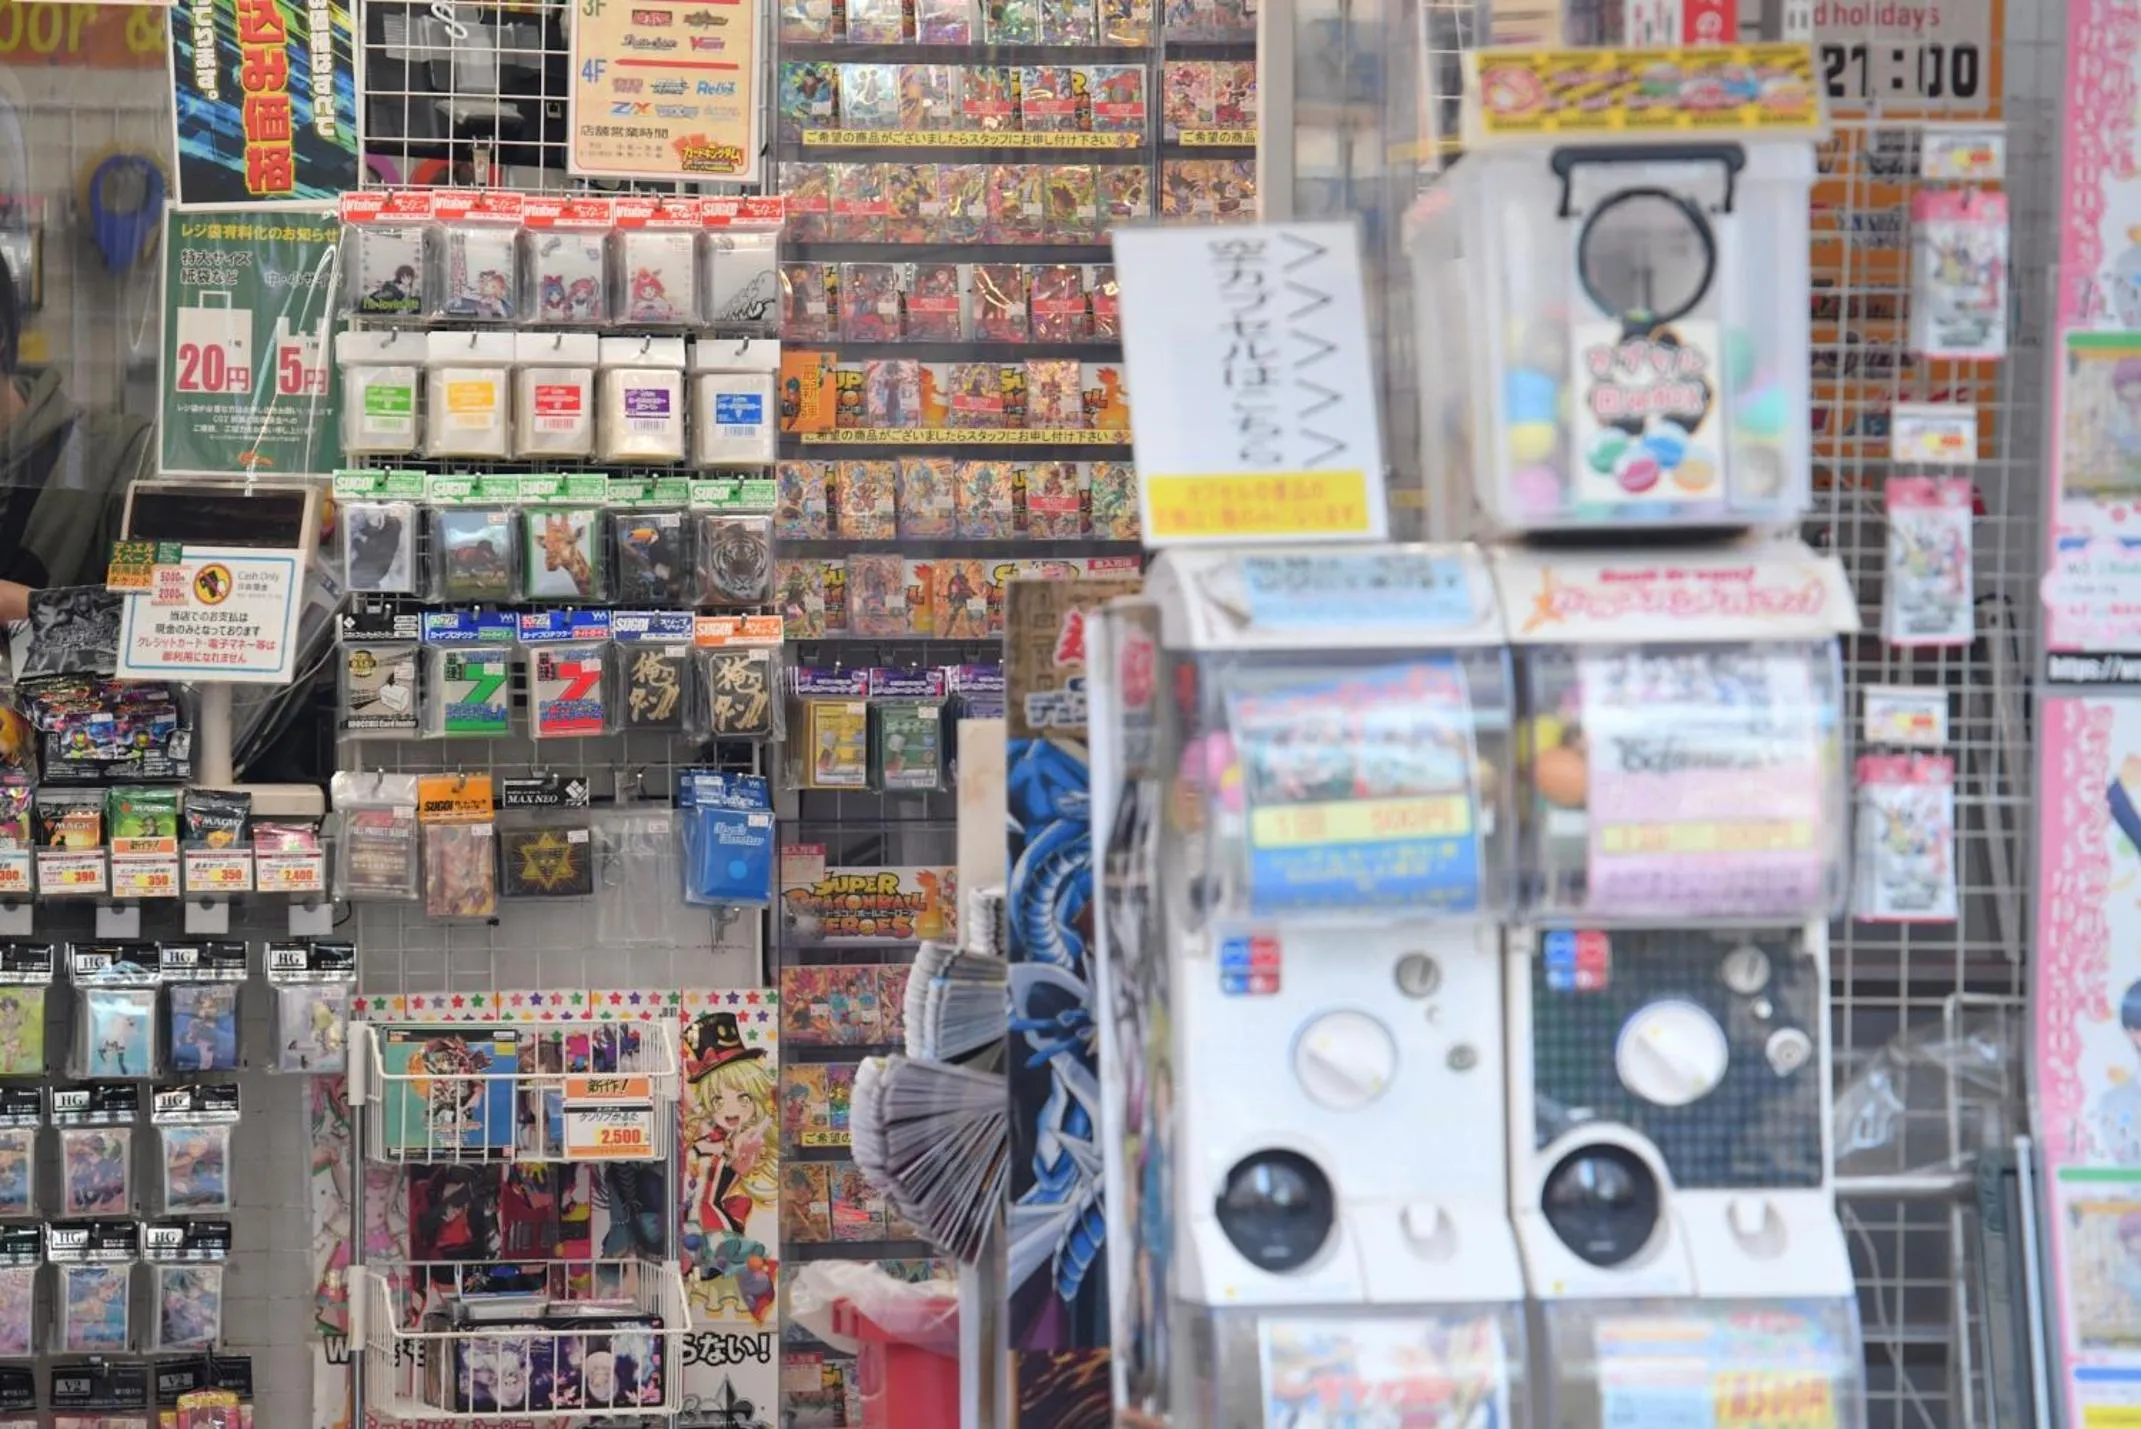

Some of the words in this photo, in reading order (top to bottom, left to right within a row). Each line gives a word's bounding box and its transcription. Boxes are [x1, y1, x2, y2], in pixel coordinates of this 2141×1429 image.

[582, 58, 607, 83] 4F
[178, 343, 249, 391] 20円
[279, 346, 327, 394] 5円
[156, 623, 260, 636] 現金のみとなっております
[507, 794, 532, 804] MAX
[533, 794, 558, 803] NEO
[54, 820, 94, 830] MAGIC
[201, 817, 243, 827] MAGIC
[813, 871, 900, 896] SUPER
[169, 950, 191, 963] HG
[278, 952, 300, 965] HG
[587, 1078, 629, 1093] 新作!
[60, 1093, 83, 1107] HG
[160, 1094, 183, 1107] HG
[58, 1231, 83, 1244] HG
[153, 1230, 177, 1243] HG
